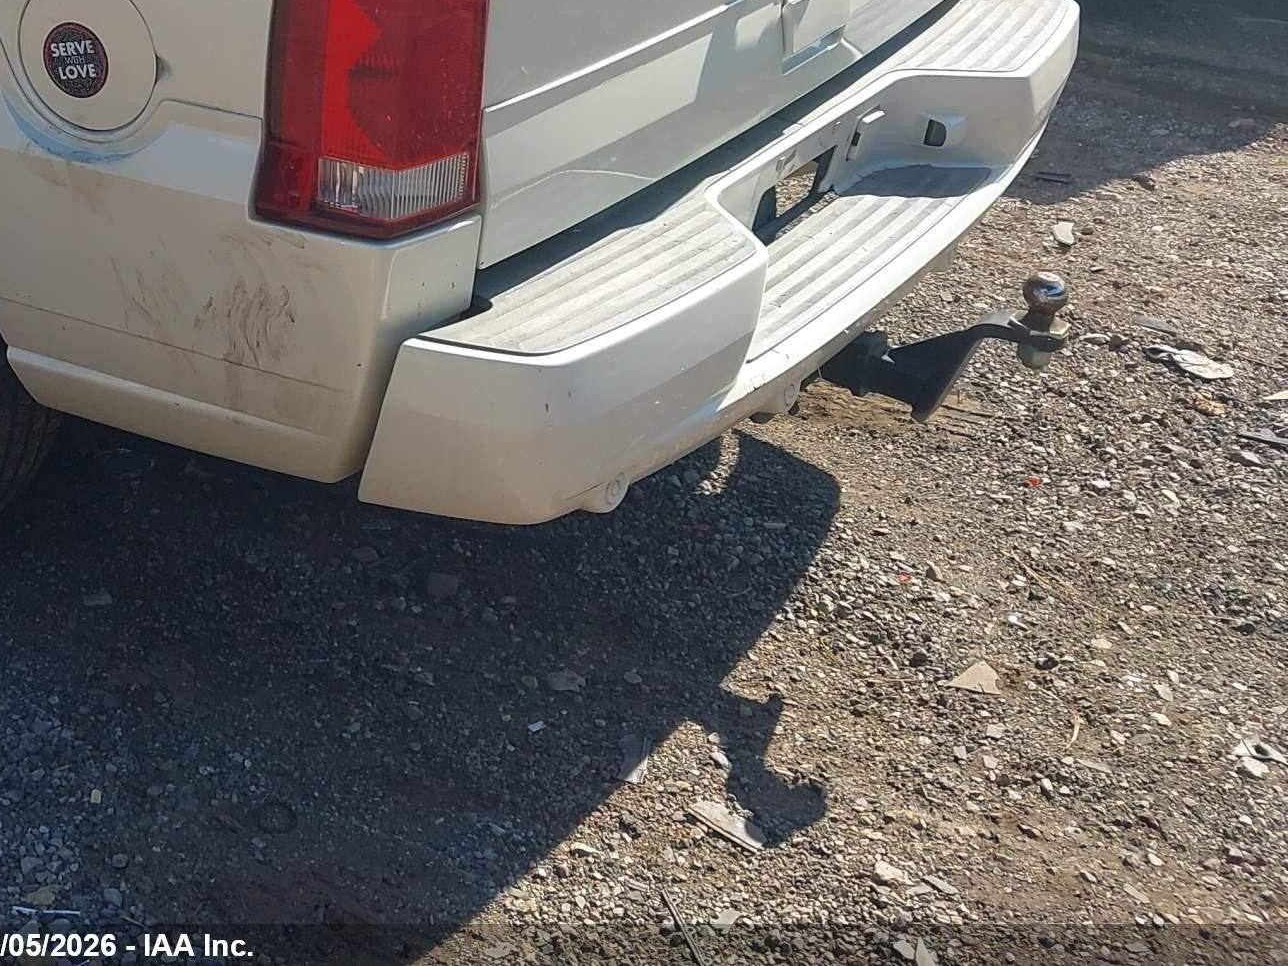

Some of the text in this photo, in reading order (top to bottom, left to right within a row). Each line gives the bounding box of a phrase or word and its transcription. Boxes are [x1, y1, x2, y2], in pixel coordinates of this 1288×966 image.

[50, 40, 95, 58] SERVE
[64, 55, 87, 65] WITH
[58, 63, 97, 80] LOVE
